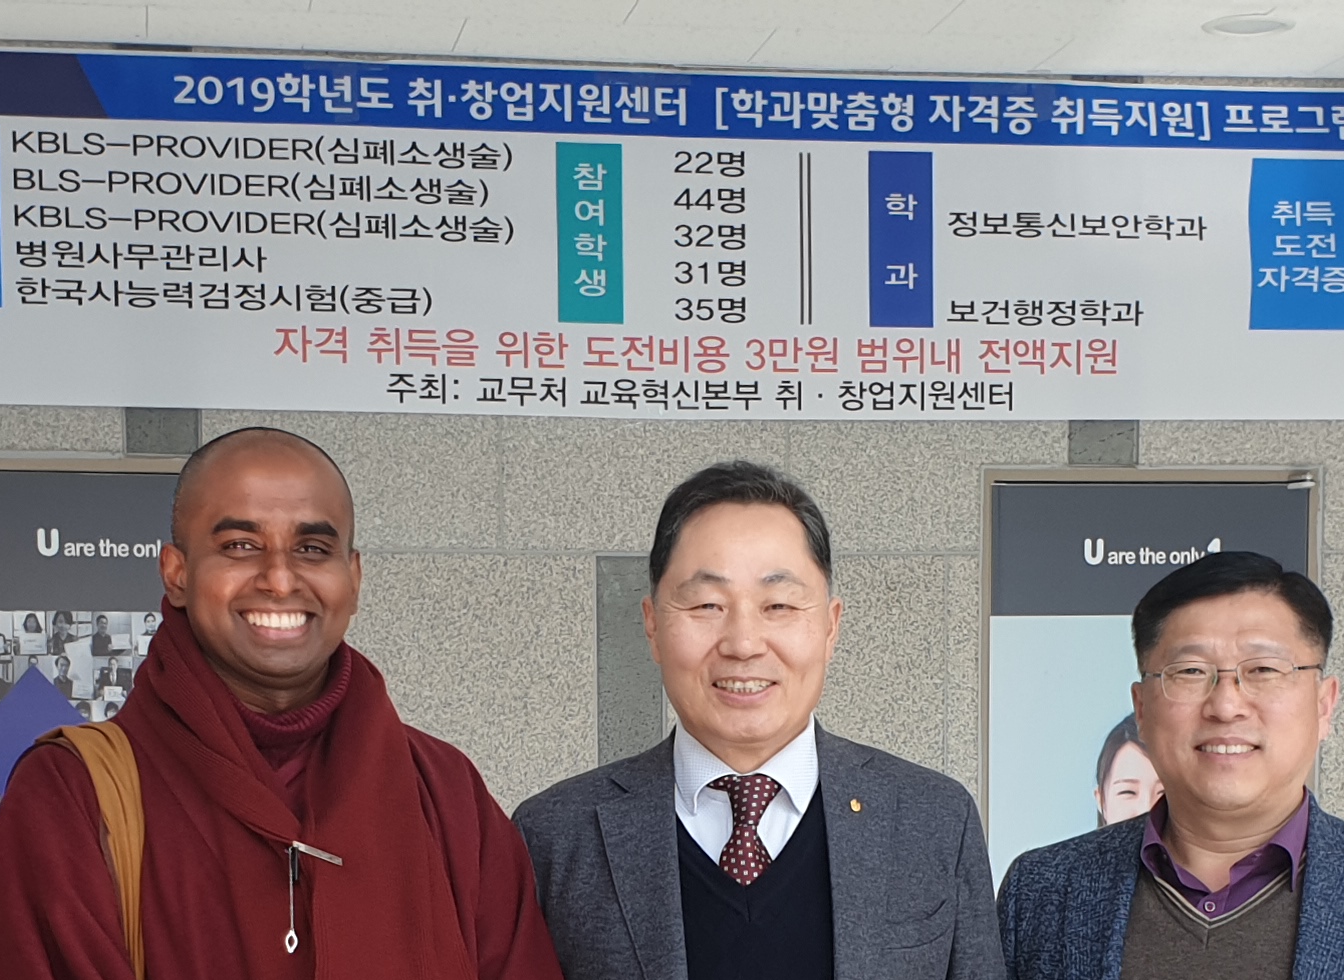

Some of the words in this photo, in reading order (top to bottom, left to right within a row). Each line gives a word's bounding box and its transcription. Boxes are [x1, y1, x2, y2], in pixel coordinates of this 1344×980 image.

[174, 73, 393, 113] 2019학년도
[716, 88, 913, 132] [학과맞춤형
[929, 96, 1037, 135] 자격증
[1052, 97, 1210, 140] 취득지원]
[674, 151, 744, 177] 22명
[674, 188, 745, 213] 44명
[1272, 201, 1334, 226] 취득
[675, 224, 745, 250] 32명
[948, 211, 1206, 240] 정보통신보안학과
[16, 241, 266, 272] 병원사무관리사
[1273, 234, 1335, 258] 도전
[675, 260, 745, 286] 31명
[16, 277, 432, 316] 한국사능력검정시험(중급)
[675, 297, 745, 323] 35명
[947, 300, 1143, 326] 보건행정학과
[274, 325, 347, 363] 자격
[367, 327, 478, 366] 취득을
[496, 332, 568, 368] 위한
[583, 335, 729, 373] 도전비용
[746, 337, 838, 372] 3만원
[858, 338, 960, 374] 범위내
[979, 339, 1116, 375] 전액지원
[387, 374, 458, 404] 주최:
[477, 377, 566, 407] 교무처
[581, 379, 761, 410] 교육혁신본부
[776, 381, 801, 410] 취
[839, 381, 1012, 411] 창업지원센터
[36, 527, 60, 557] U
[63, 541, 95, 557] are
[99, 538, 129, 557] the
[1083, 538, 1104, 566] U
[1107, 550, 1136, 566] are
[1139, 547, 1167, 566] the
